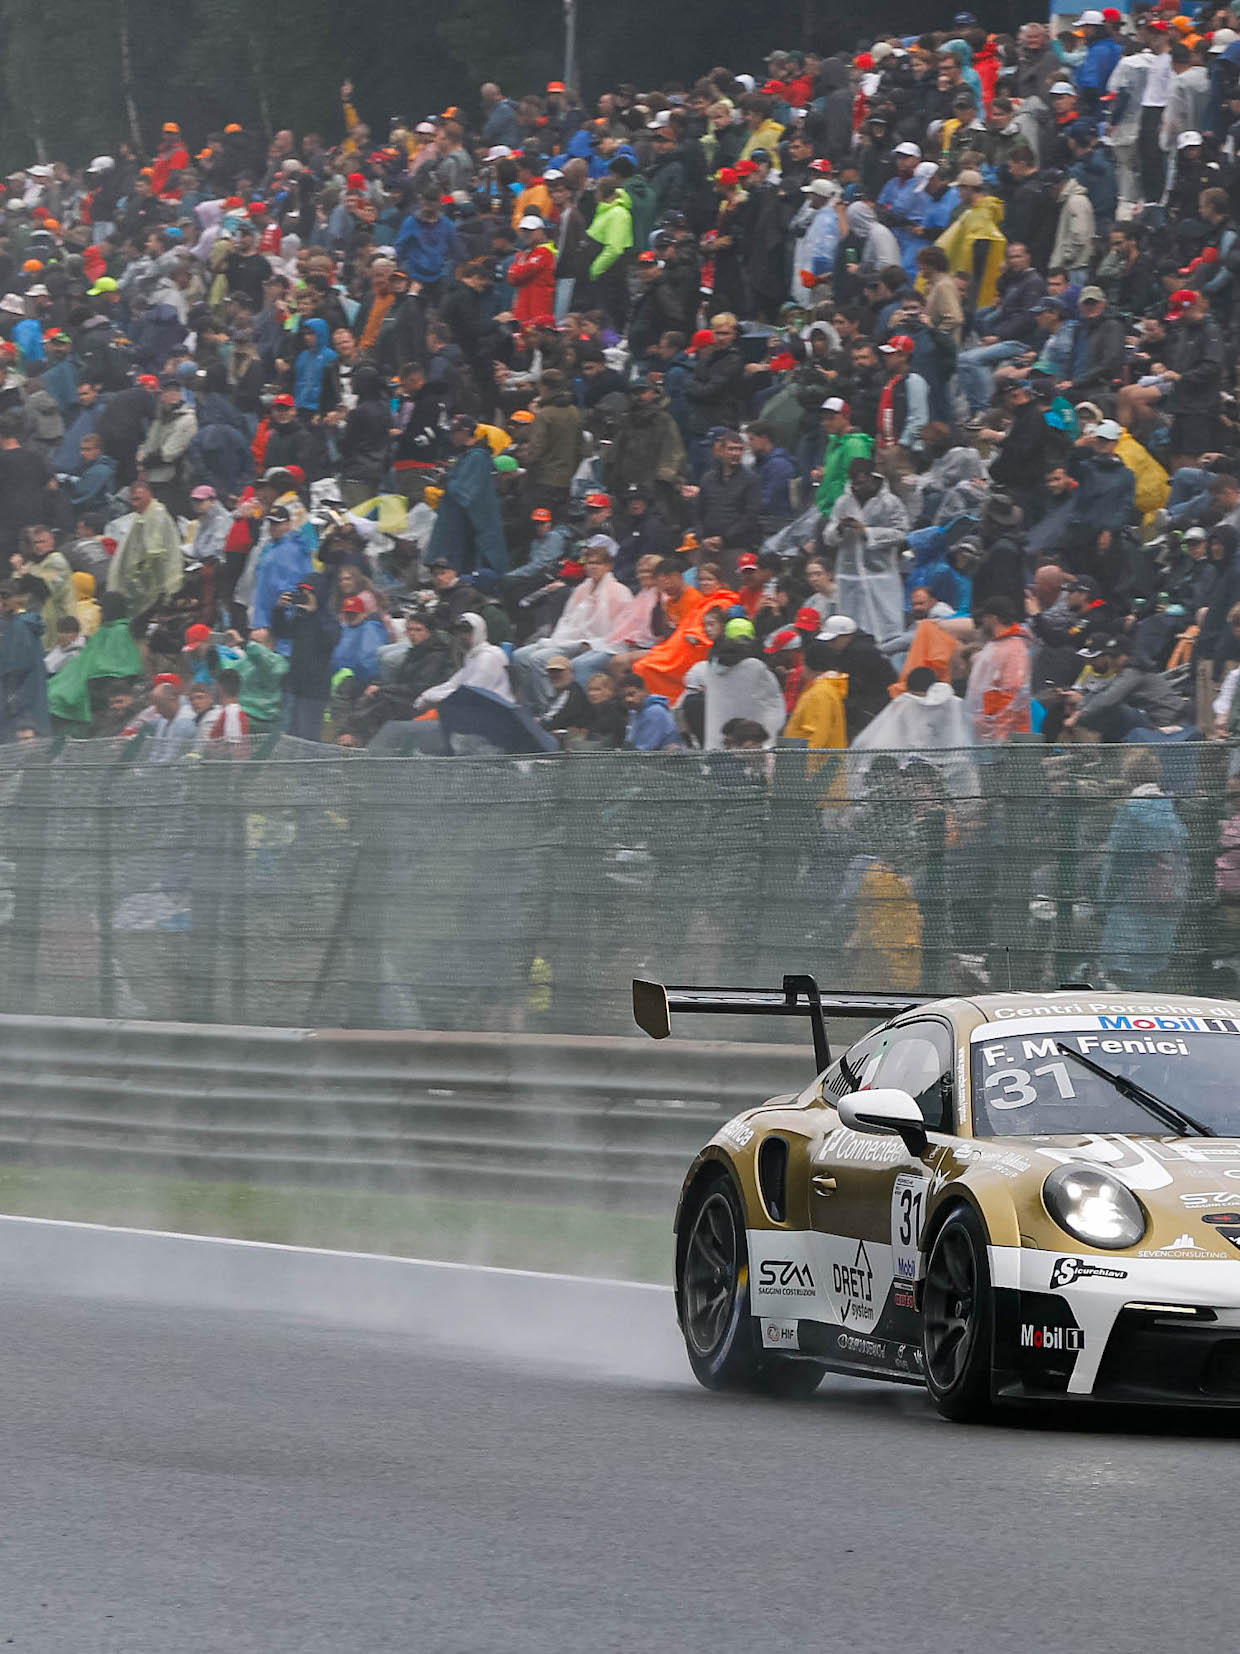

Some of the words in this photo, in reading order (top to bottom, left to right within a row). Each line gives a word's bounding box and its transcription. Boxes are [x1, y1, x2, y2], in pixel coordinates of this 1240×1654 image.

[994, 1004, 1083, 1021] Centri
[1088, 1003, 1203, 1017] Porsche
[1209, 1006, 1238, 1019] di
[1098, 1016, 1201, 1032] Mobil
[982, 1044, 1015, 1067] F.
[1076, 1036, 1192, 1057] Fenici
[984, 1061, 1077, 1111] 31
[899, 1188, 923, 1246] 31
[758, 1287, 782, 1295] SAGGINI
[851, 1302, 874, 1321] system
[781, 1327, 795, 1341] HIF
[1021, 1323, 1063, 1350] Mobil
